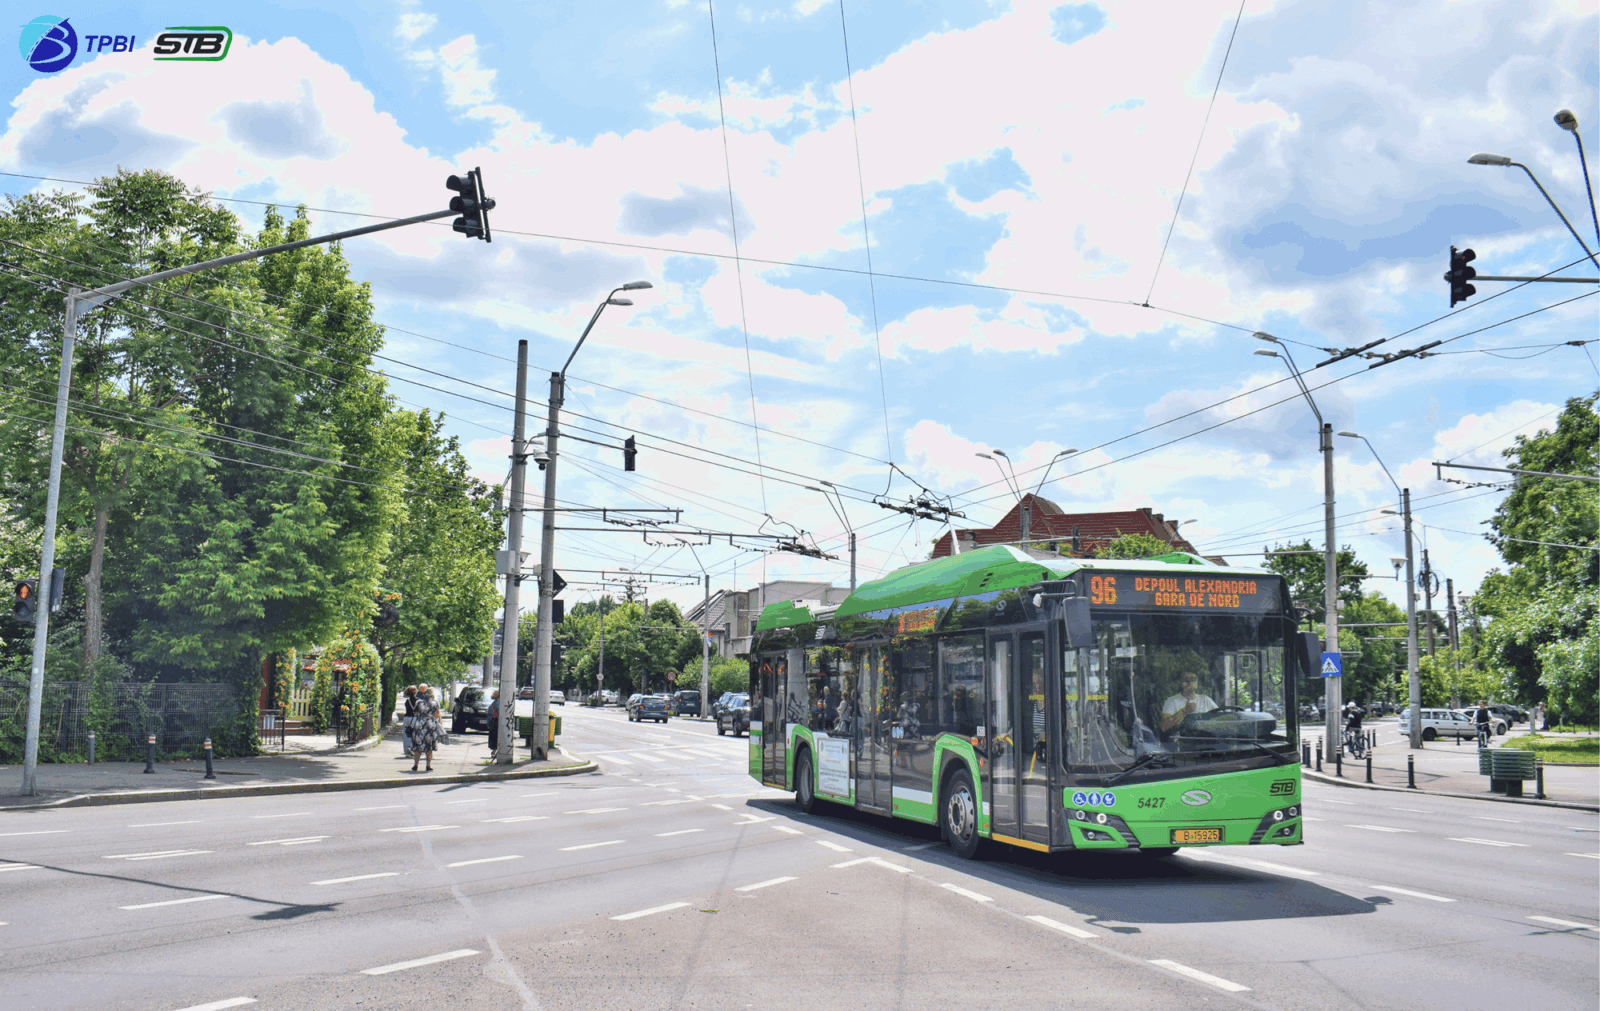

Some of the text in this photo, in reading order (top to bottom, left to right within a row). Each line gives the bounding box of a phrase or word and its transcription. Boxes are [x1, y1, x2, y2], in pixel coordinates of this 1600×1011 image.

[1090, 576, 1117, 605] 96
[1135, 577, 1257, 595] DEPOUL ALEXANDRIA
[1154, 592, 1240, 608] GARA DE NORD
[1269, 782, 1294, 793] STB
[1137, 797, 1166, 809] 5427
